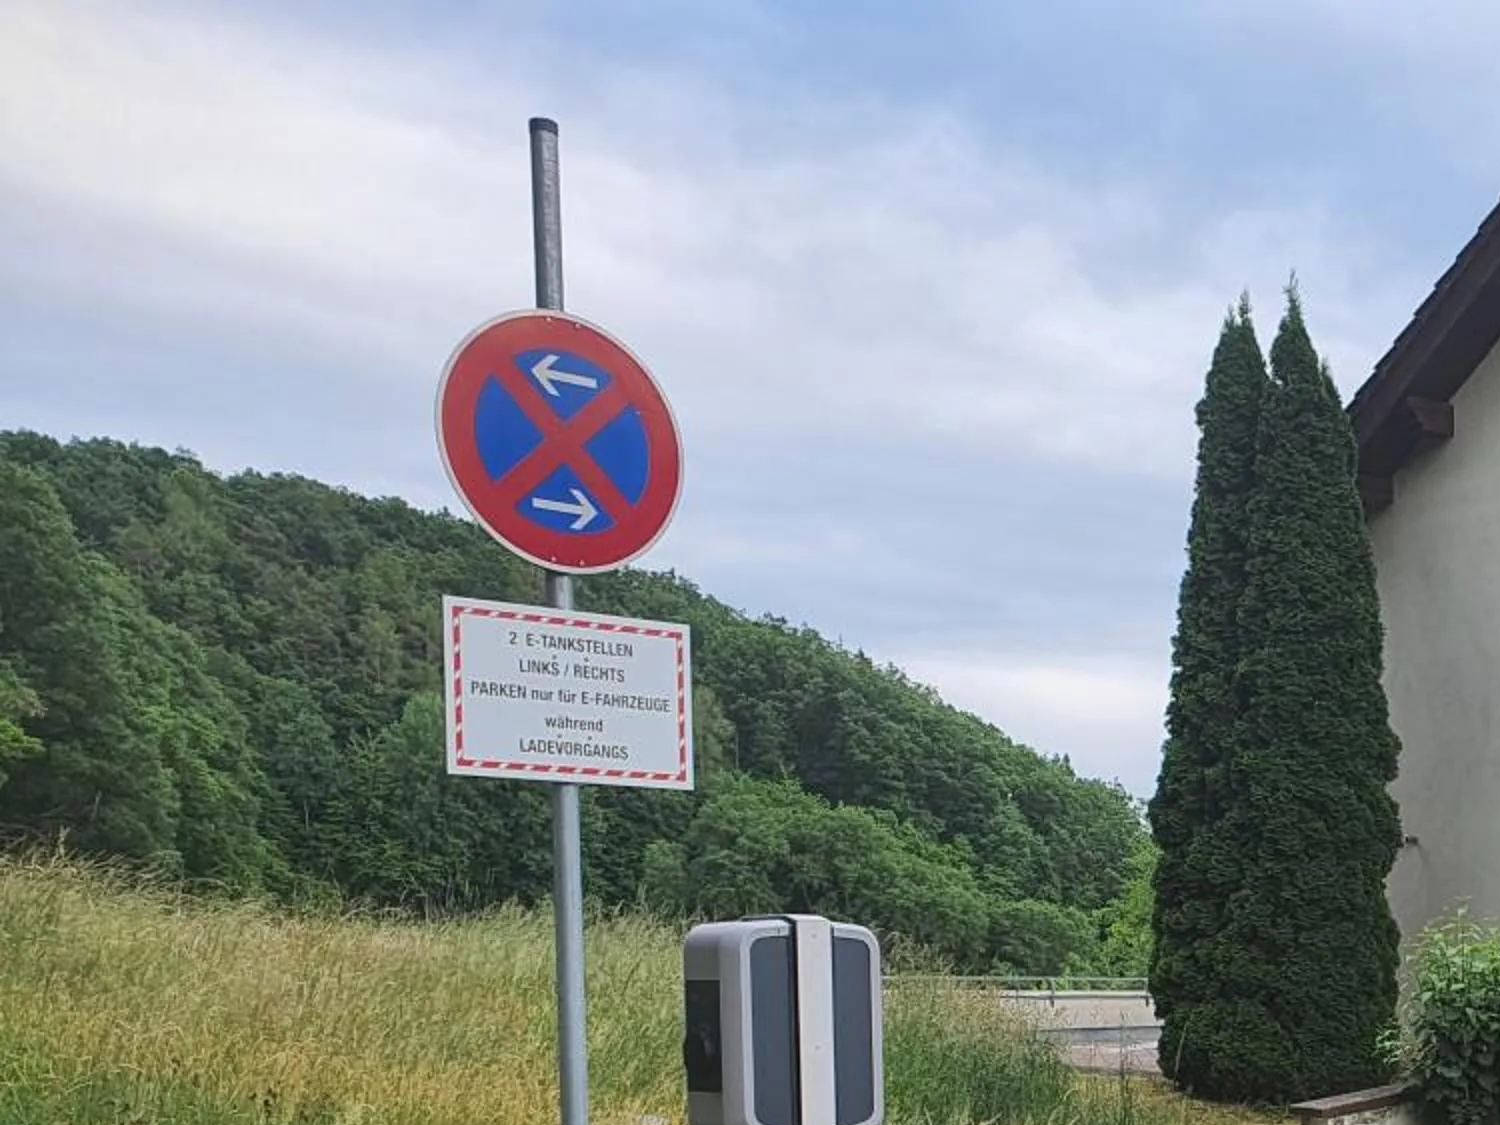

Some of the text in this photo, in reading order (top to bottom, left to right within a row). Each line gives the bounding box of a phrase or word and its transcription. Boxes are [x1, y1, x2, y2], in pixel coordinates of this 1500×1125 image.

[508, 631, 634, 657] 2 E-TANKSTELLEN
[519, 659, 625, 682] LINKS / RECHTS
[470, 681, 672, 713] PARKEN nur für E-FAHRZEUGE
[544, 715, 604, 732] während
[519, 738, 629, 760] LADEVORGANGS
